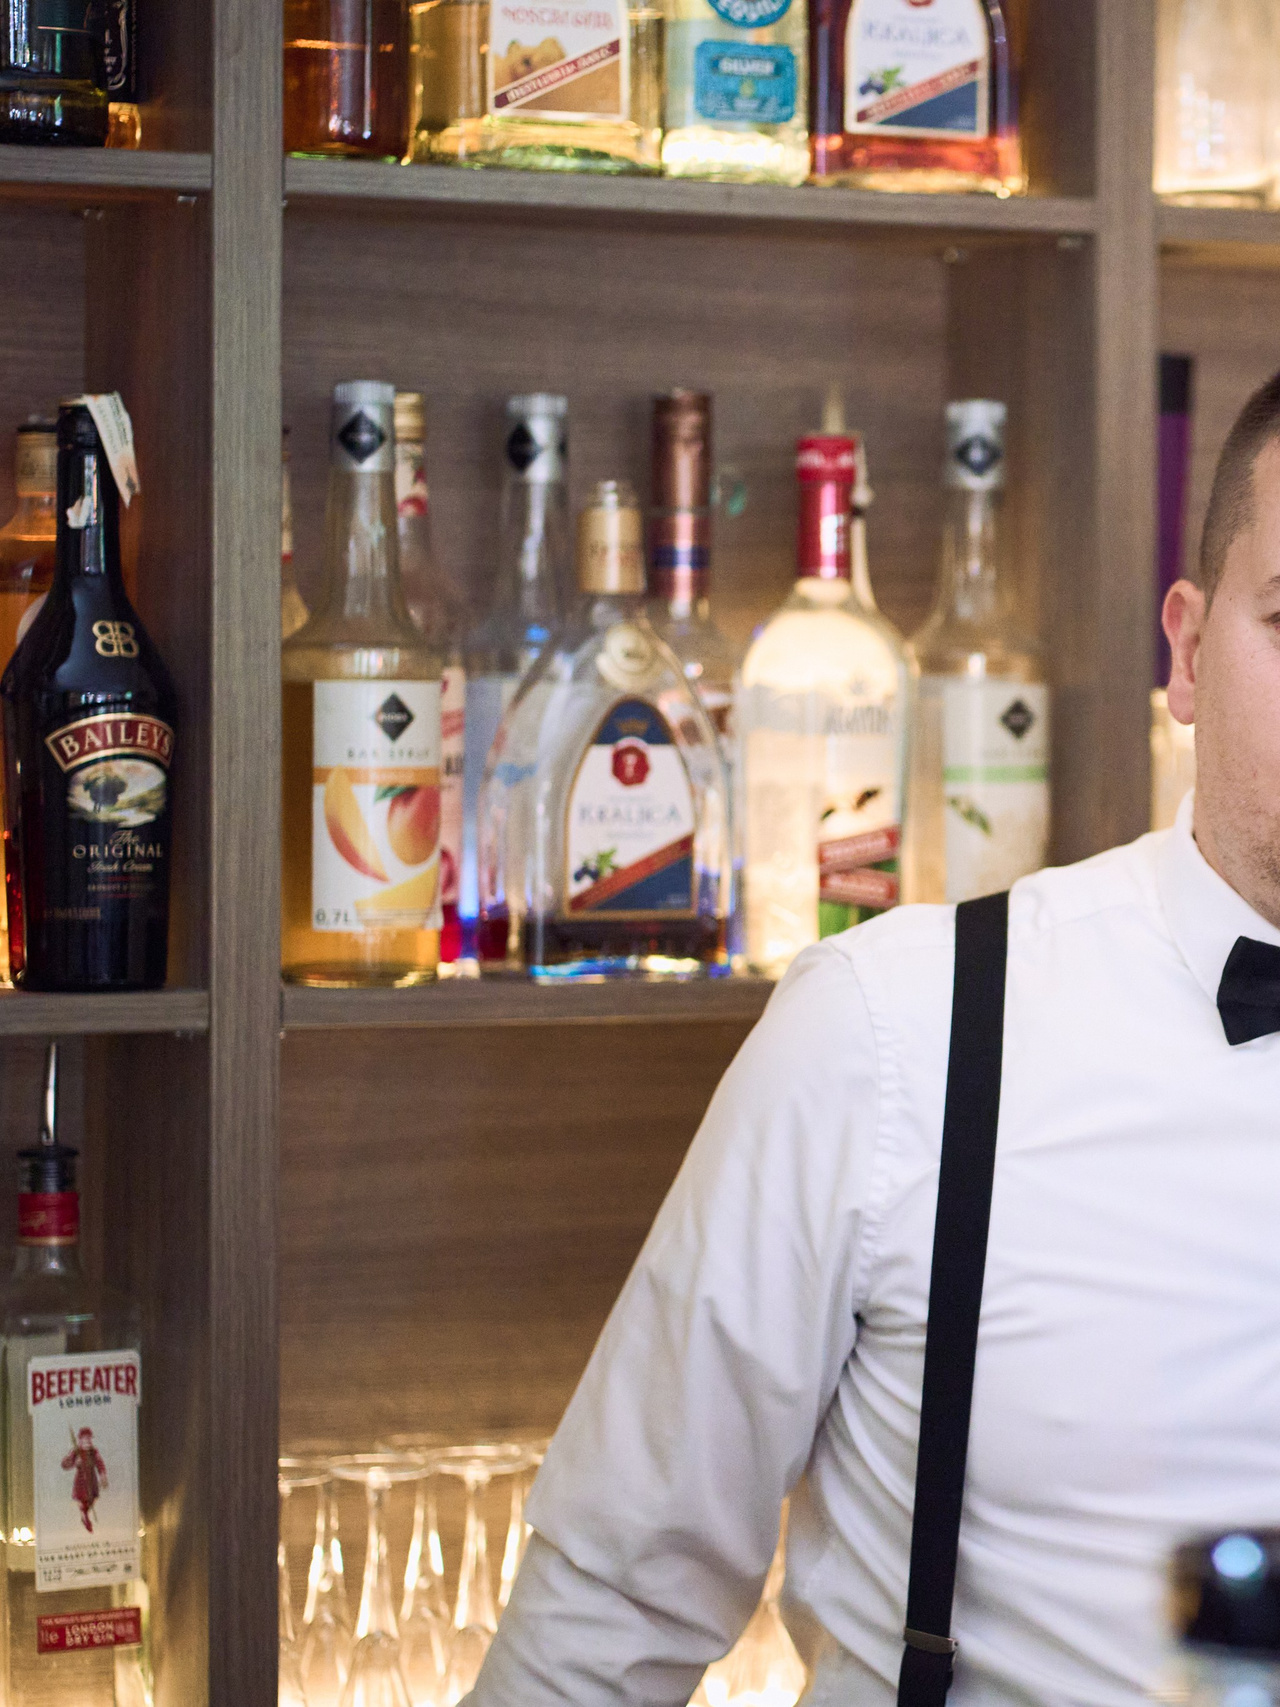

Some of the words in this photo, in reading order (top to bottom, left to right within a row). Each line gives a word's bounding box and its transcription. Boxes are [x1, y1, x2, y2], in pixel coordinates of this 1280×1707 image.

[58, 721, 172, 759] BAILEYS
[72, 843, 163, 859] ORIGINAL
[31, 1363, 138, 1406] BEEFEATER
[59, 1394, 111, 1409] LONDON
[65, 1621, 115, 1638] LONDON
